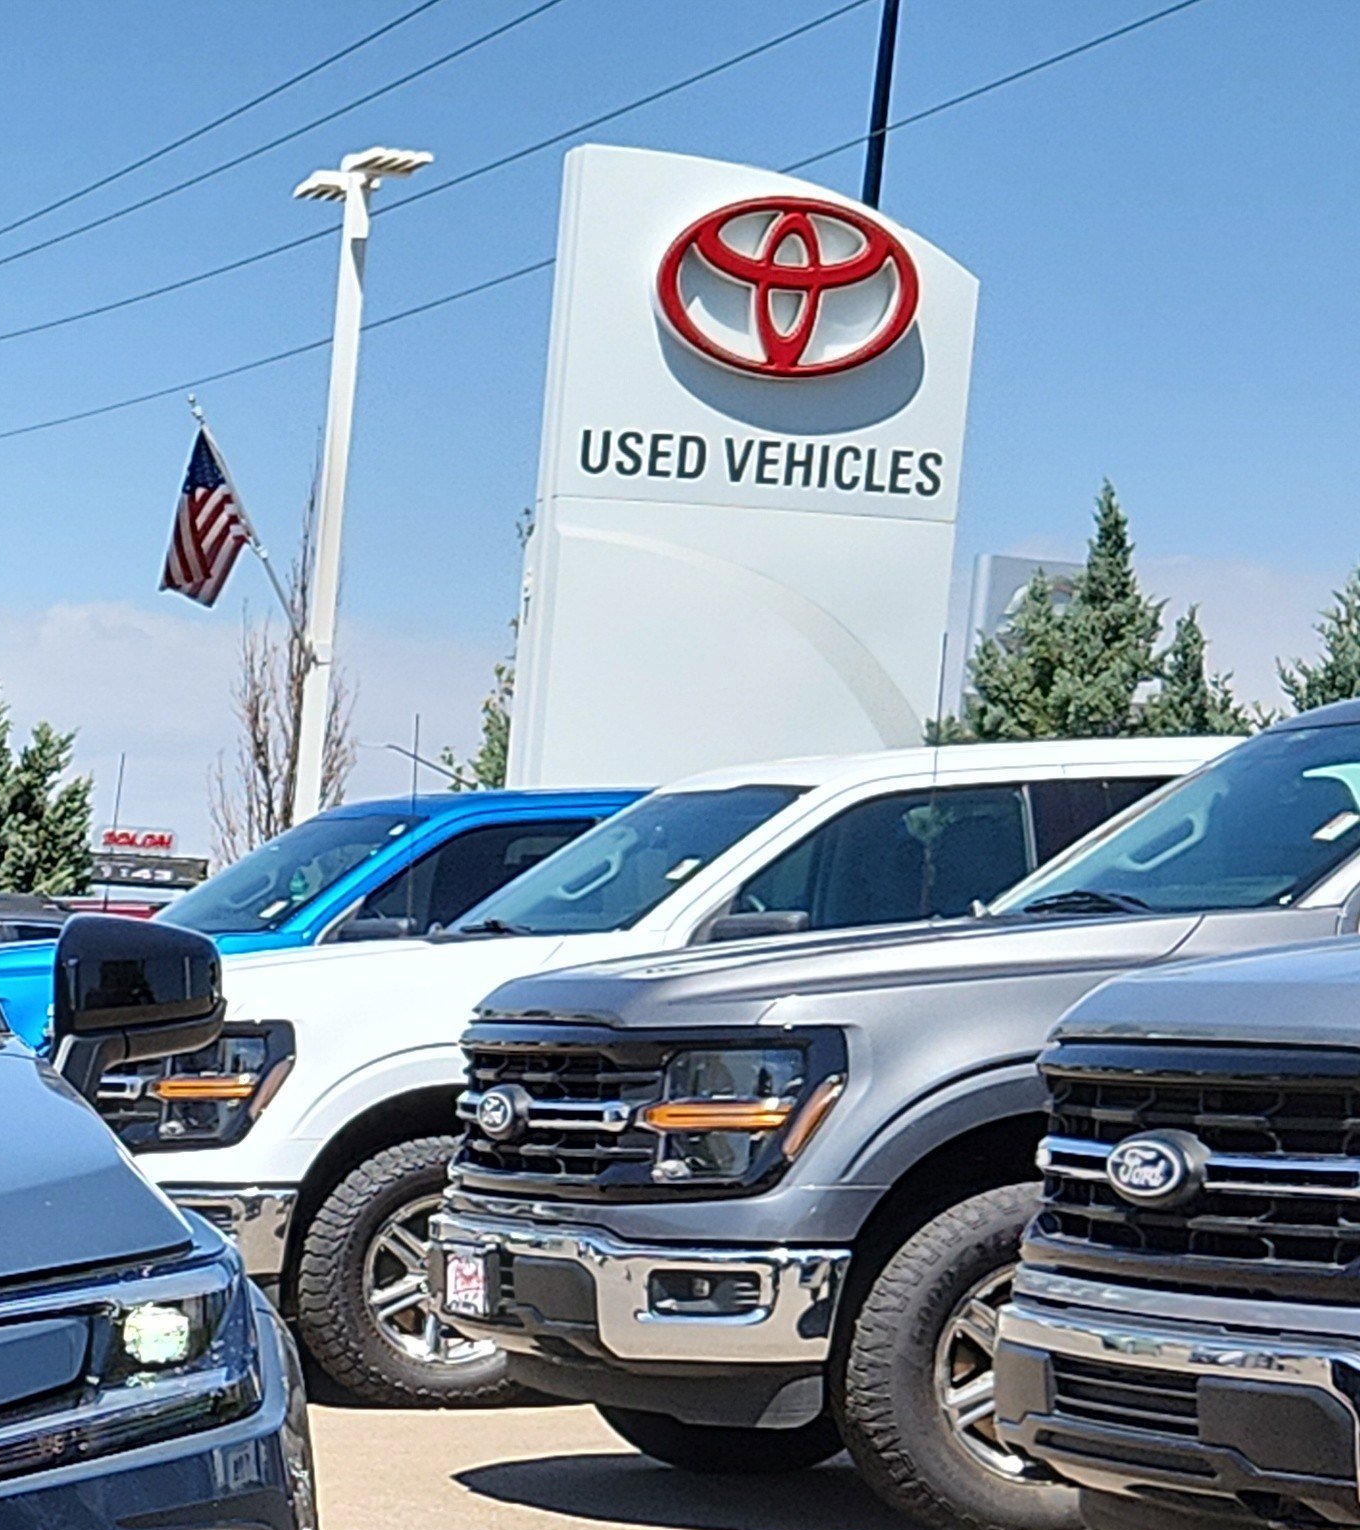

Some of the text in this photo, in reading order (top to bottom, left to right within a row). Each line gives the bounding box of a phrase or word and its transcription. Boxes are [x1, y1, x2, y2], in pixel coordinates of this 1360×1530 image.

[581, 429, 944, 497] USED VEHICLES
[1118, 1147, 1167, 1188] Ford
